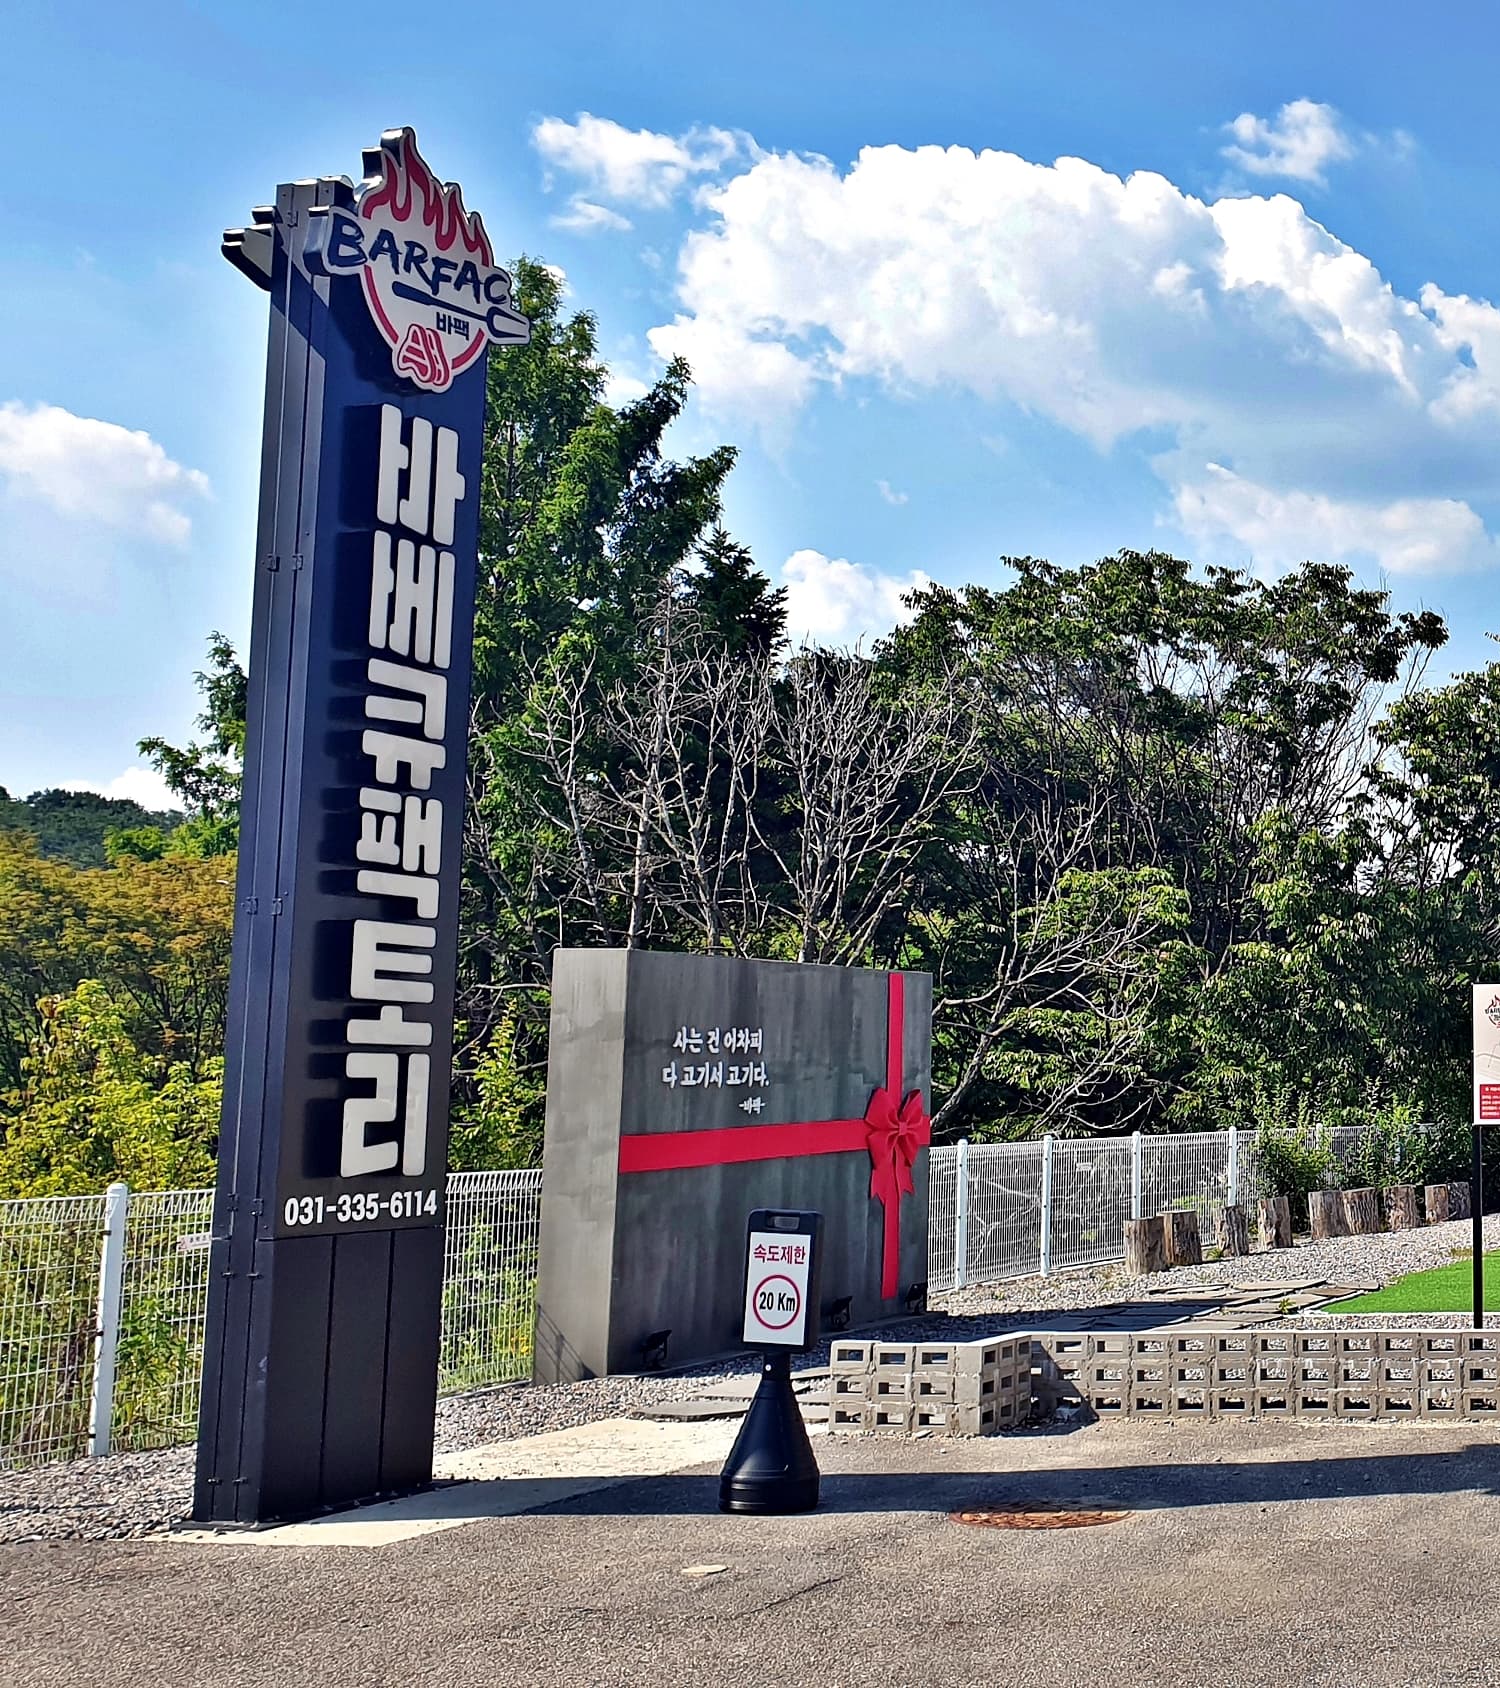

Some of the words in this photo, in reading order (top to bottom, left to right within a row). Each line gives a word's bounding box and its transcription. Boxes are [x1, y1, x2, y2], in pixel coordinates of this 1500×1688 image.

[329, 211, 510, 305] BARFAC
[436, 311, 470, 341] 바팩
[340, 403, 466, 1178] 바베큐팩토리
[673, 1026, 703, 1053] 사는
[706, 1027, 720, 1054] 건
[723, 1027, 763, 1055] 어차피
[662, 1061, 678, 1089] 다
[680, 1061, 723, 1089] 고기서
[726, 1061, 770, 1088] 고기다.
[284, 1189, 437, 1226] 031-335-6114
[753, 1244, 806, 1265] 속도제한
[759, 1291, 774, 1311] 20
[777, 1292, 796, 1312] Km
